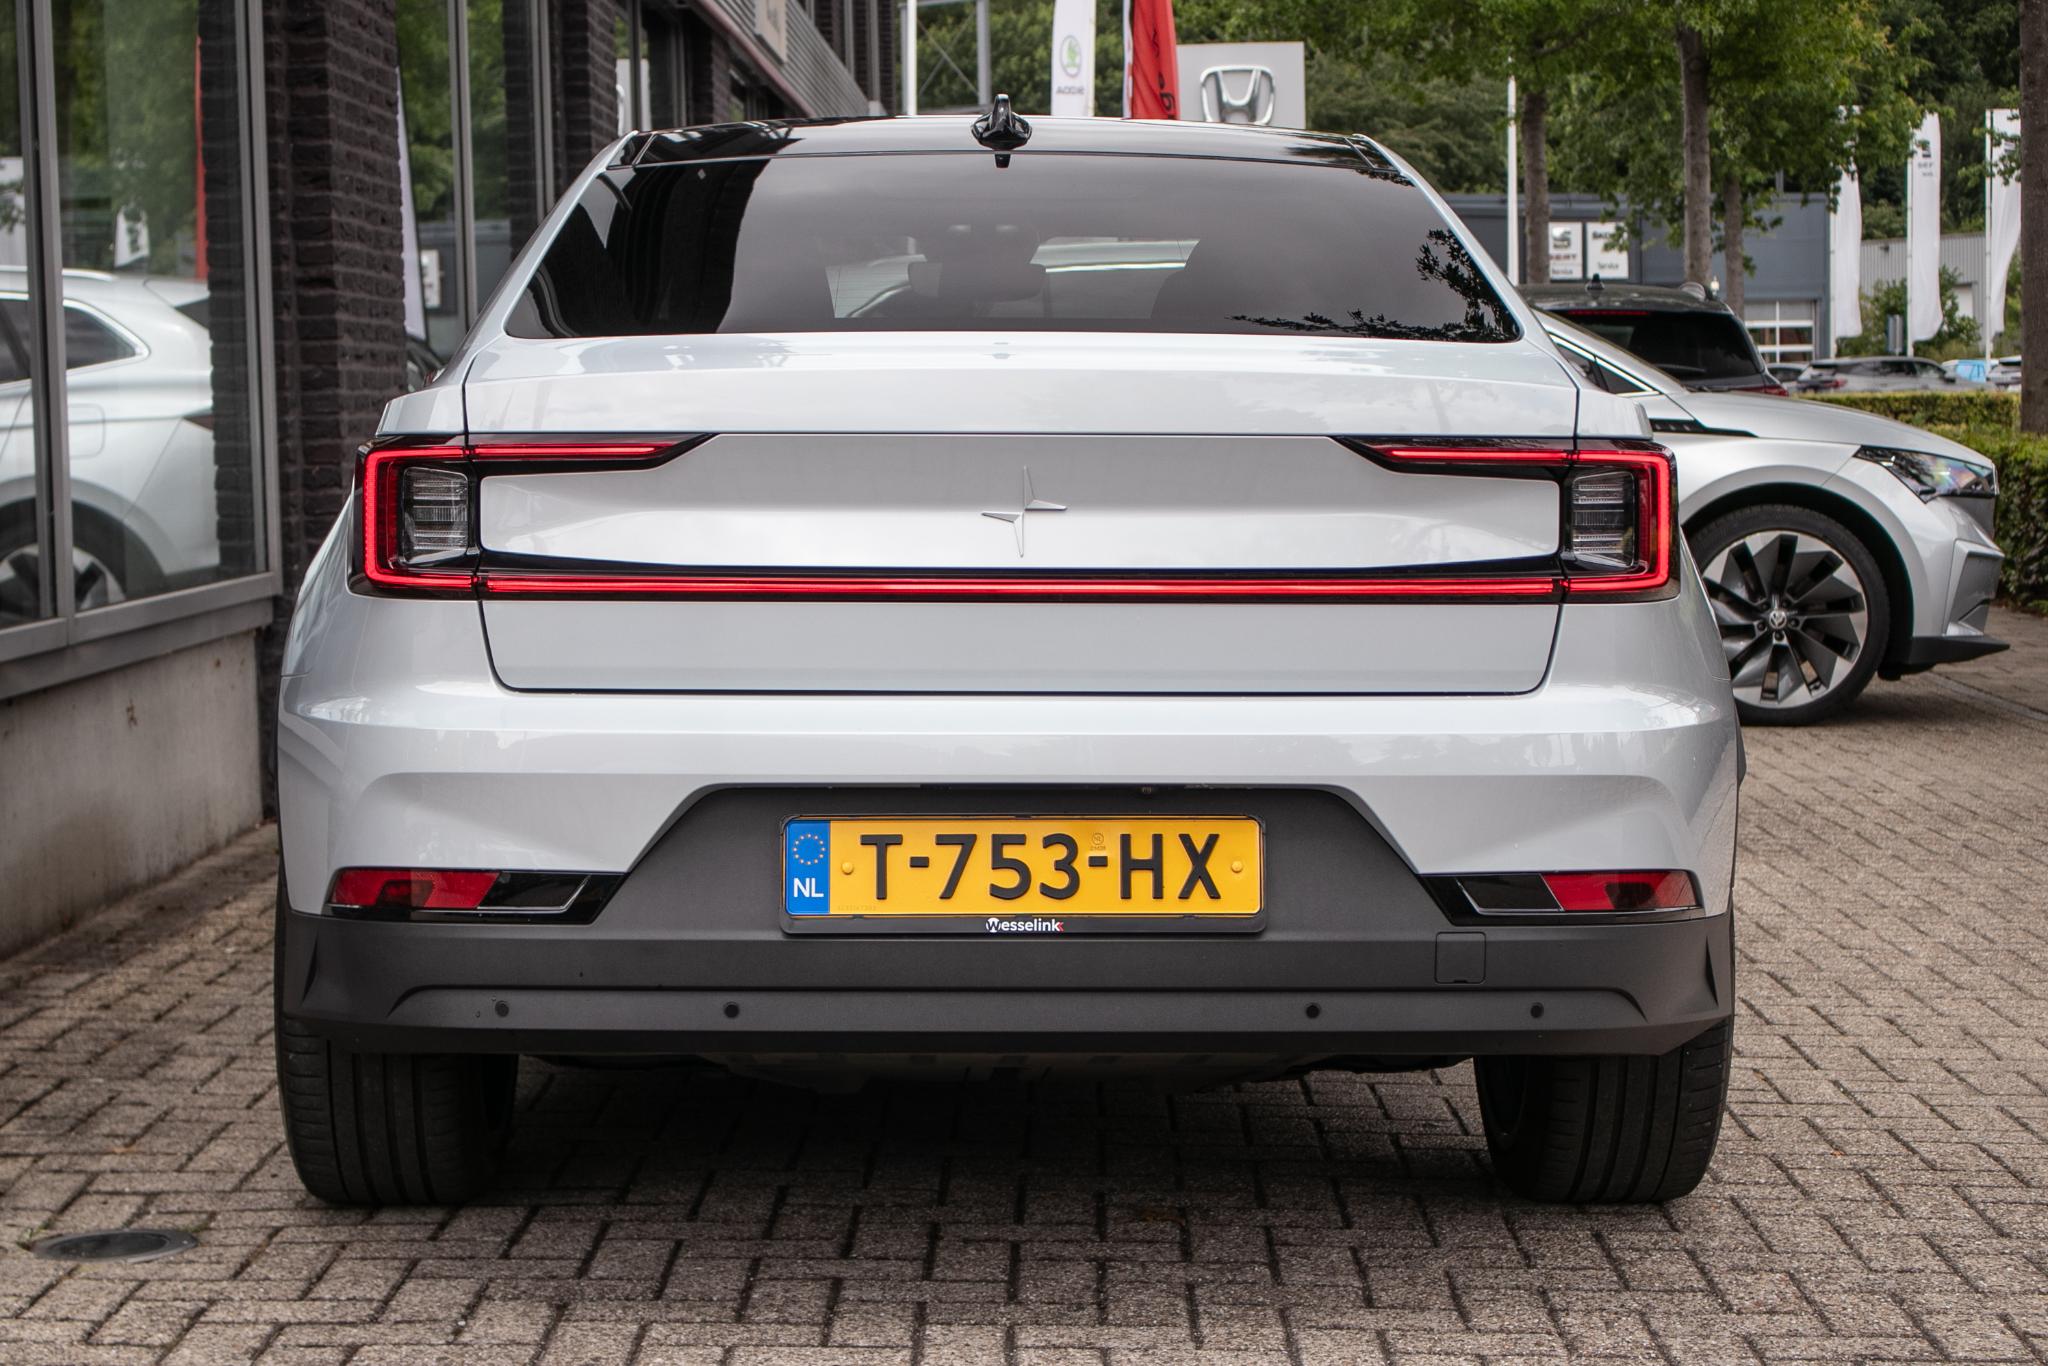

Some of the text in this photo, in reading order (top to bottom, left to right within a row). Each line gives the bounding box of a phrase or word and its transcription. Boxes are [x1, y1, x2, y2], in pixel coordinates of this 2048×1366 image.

[860, 833, 1221, 900] T-753-HX
[793, 878, 824, 898] NL
[985, 917, 1064, 933] Wesselink
